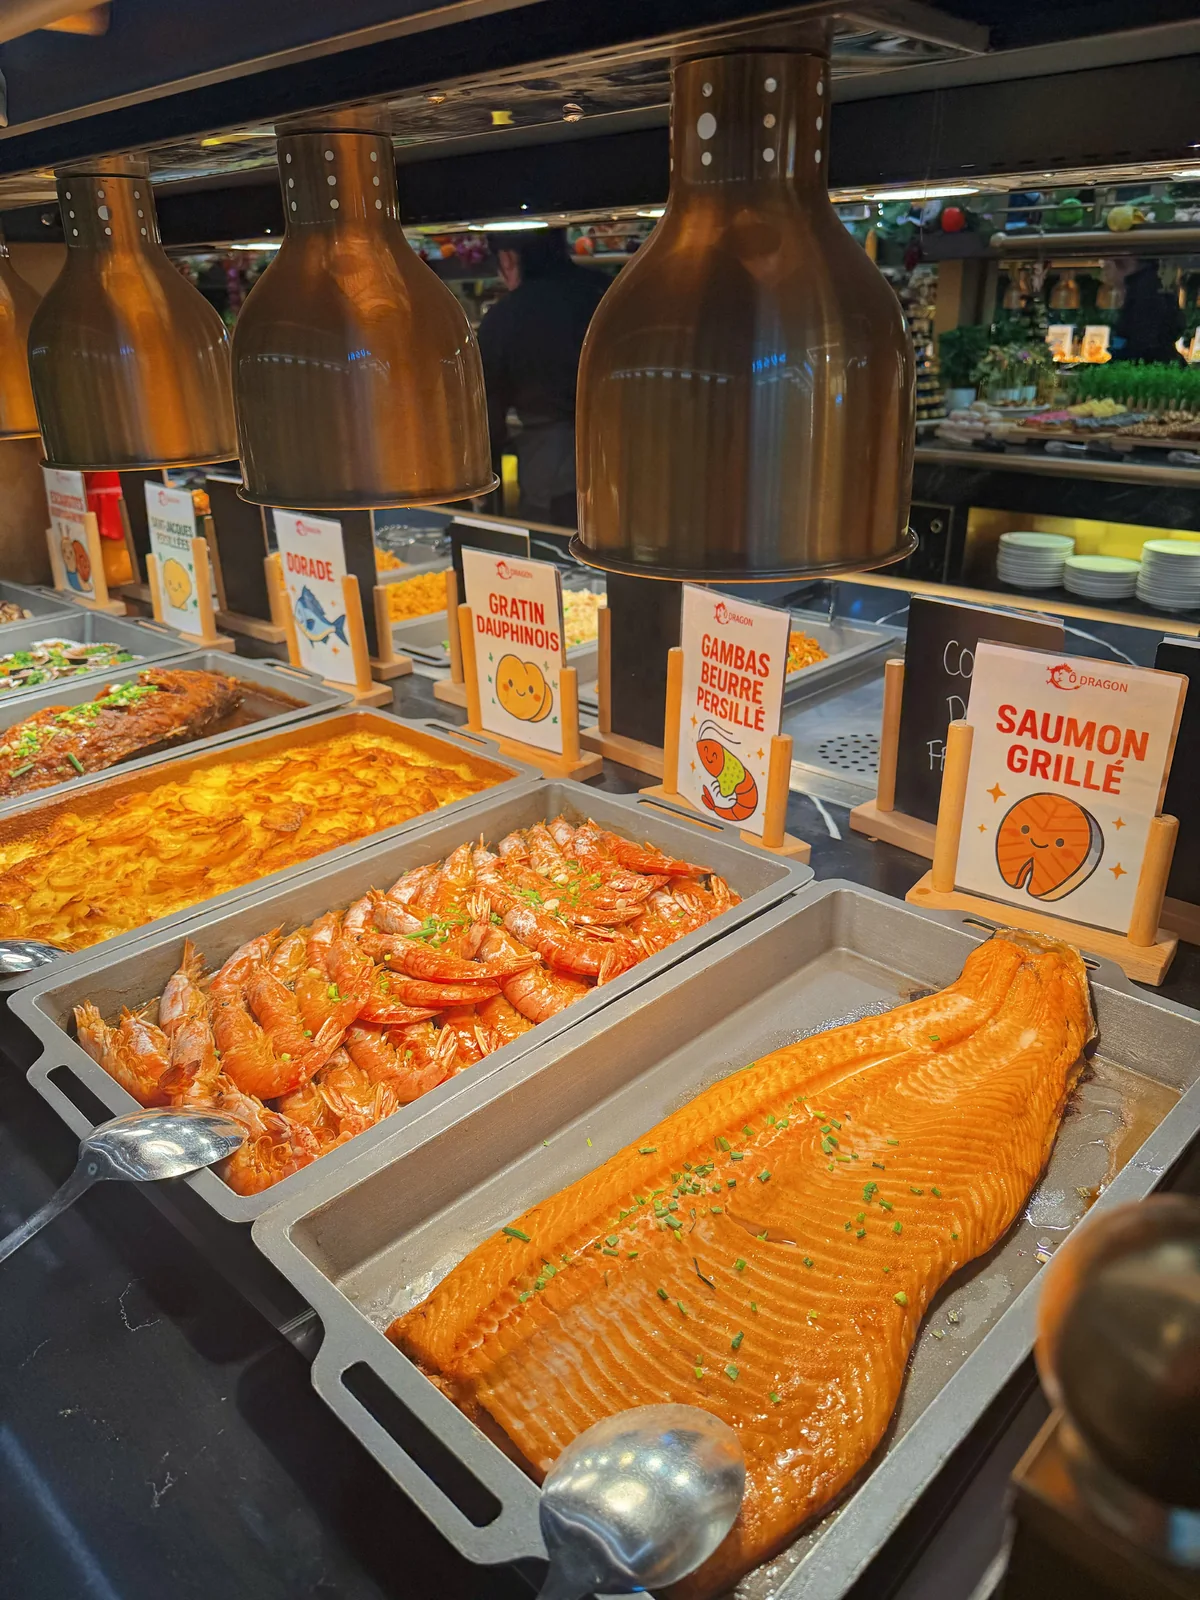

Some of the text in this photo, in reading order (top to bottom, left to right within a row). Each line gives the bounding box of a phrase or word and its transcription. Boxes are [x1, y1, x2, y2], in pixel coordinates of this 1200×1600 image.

[286, 551, 335, 583] DORADE
[489, 593, 545, 625] GRATIN
[728, 613, 753, 627] DRAGON
[476, 614, 560, 652] DAUPHINOIS
[701, 633, 771, 678] GAMBAS
[943, 640, 975, 679] CO
[701, 661, 764, 705] BEURRE
[1068, 672, 1128, 693] Ô DRAGON
[696, 685, 766, 732] PERSILLÉ
[996, 704, 1150, 762] SAUMON
[1006, 744, 1125, 795] GRILLÉ
